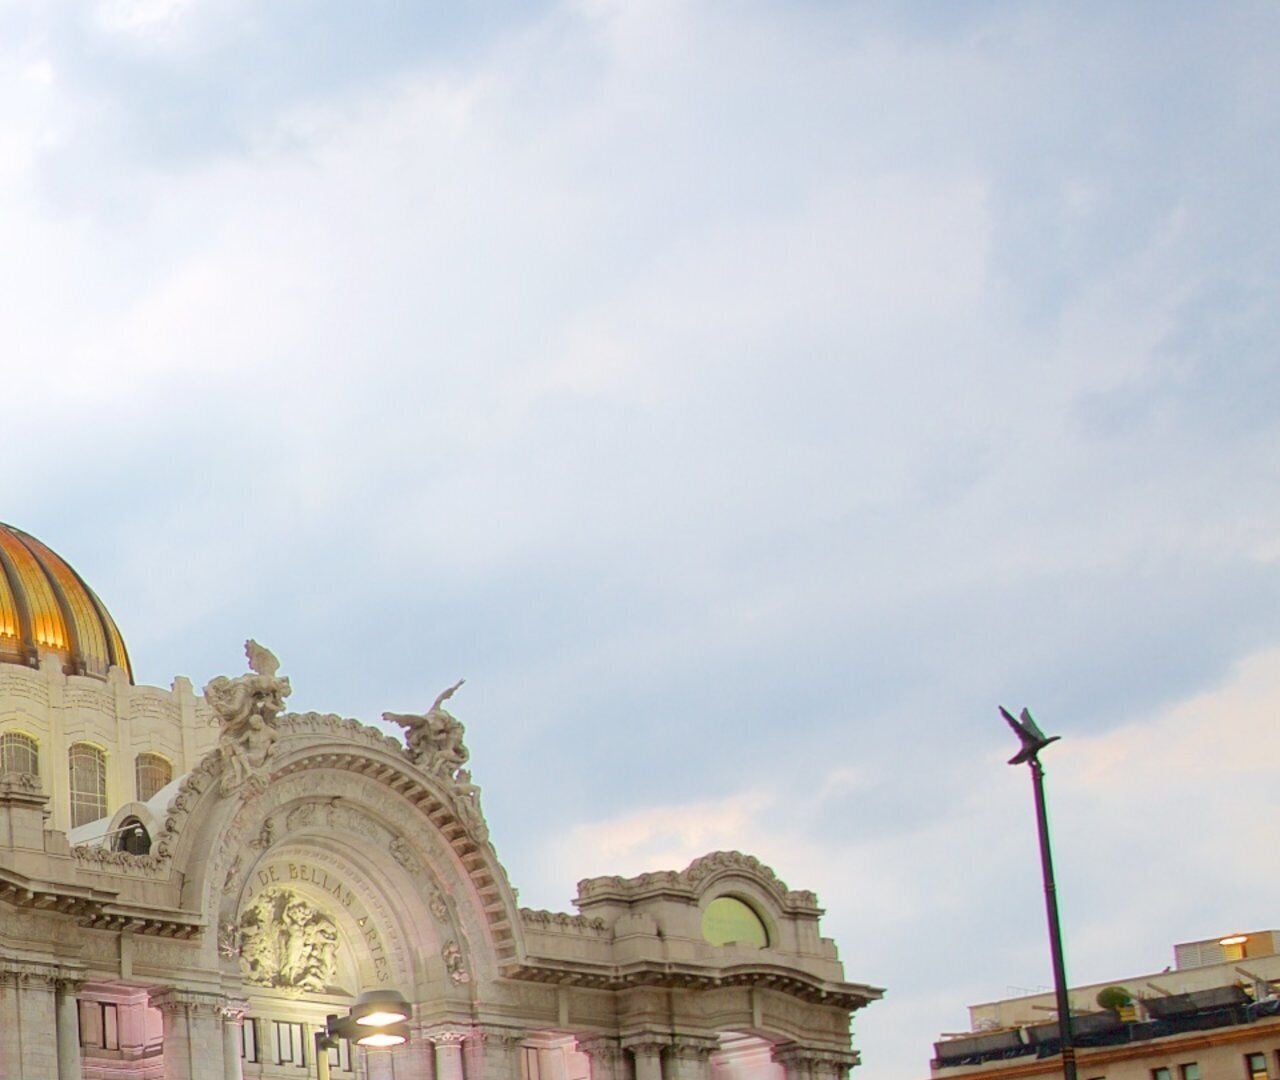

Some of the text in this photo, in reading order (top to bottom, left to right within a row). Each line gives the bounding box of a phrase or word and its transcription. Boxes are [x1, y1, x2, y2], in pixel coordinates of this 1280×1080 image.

[257, 863, 389, 982] DE BELLAS ARTES
